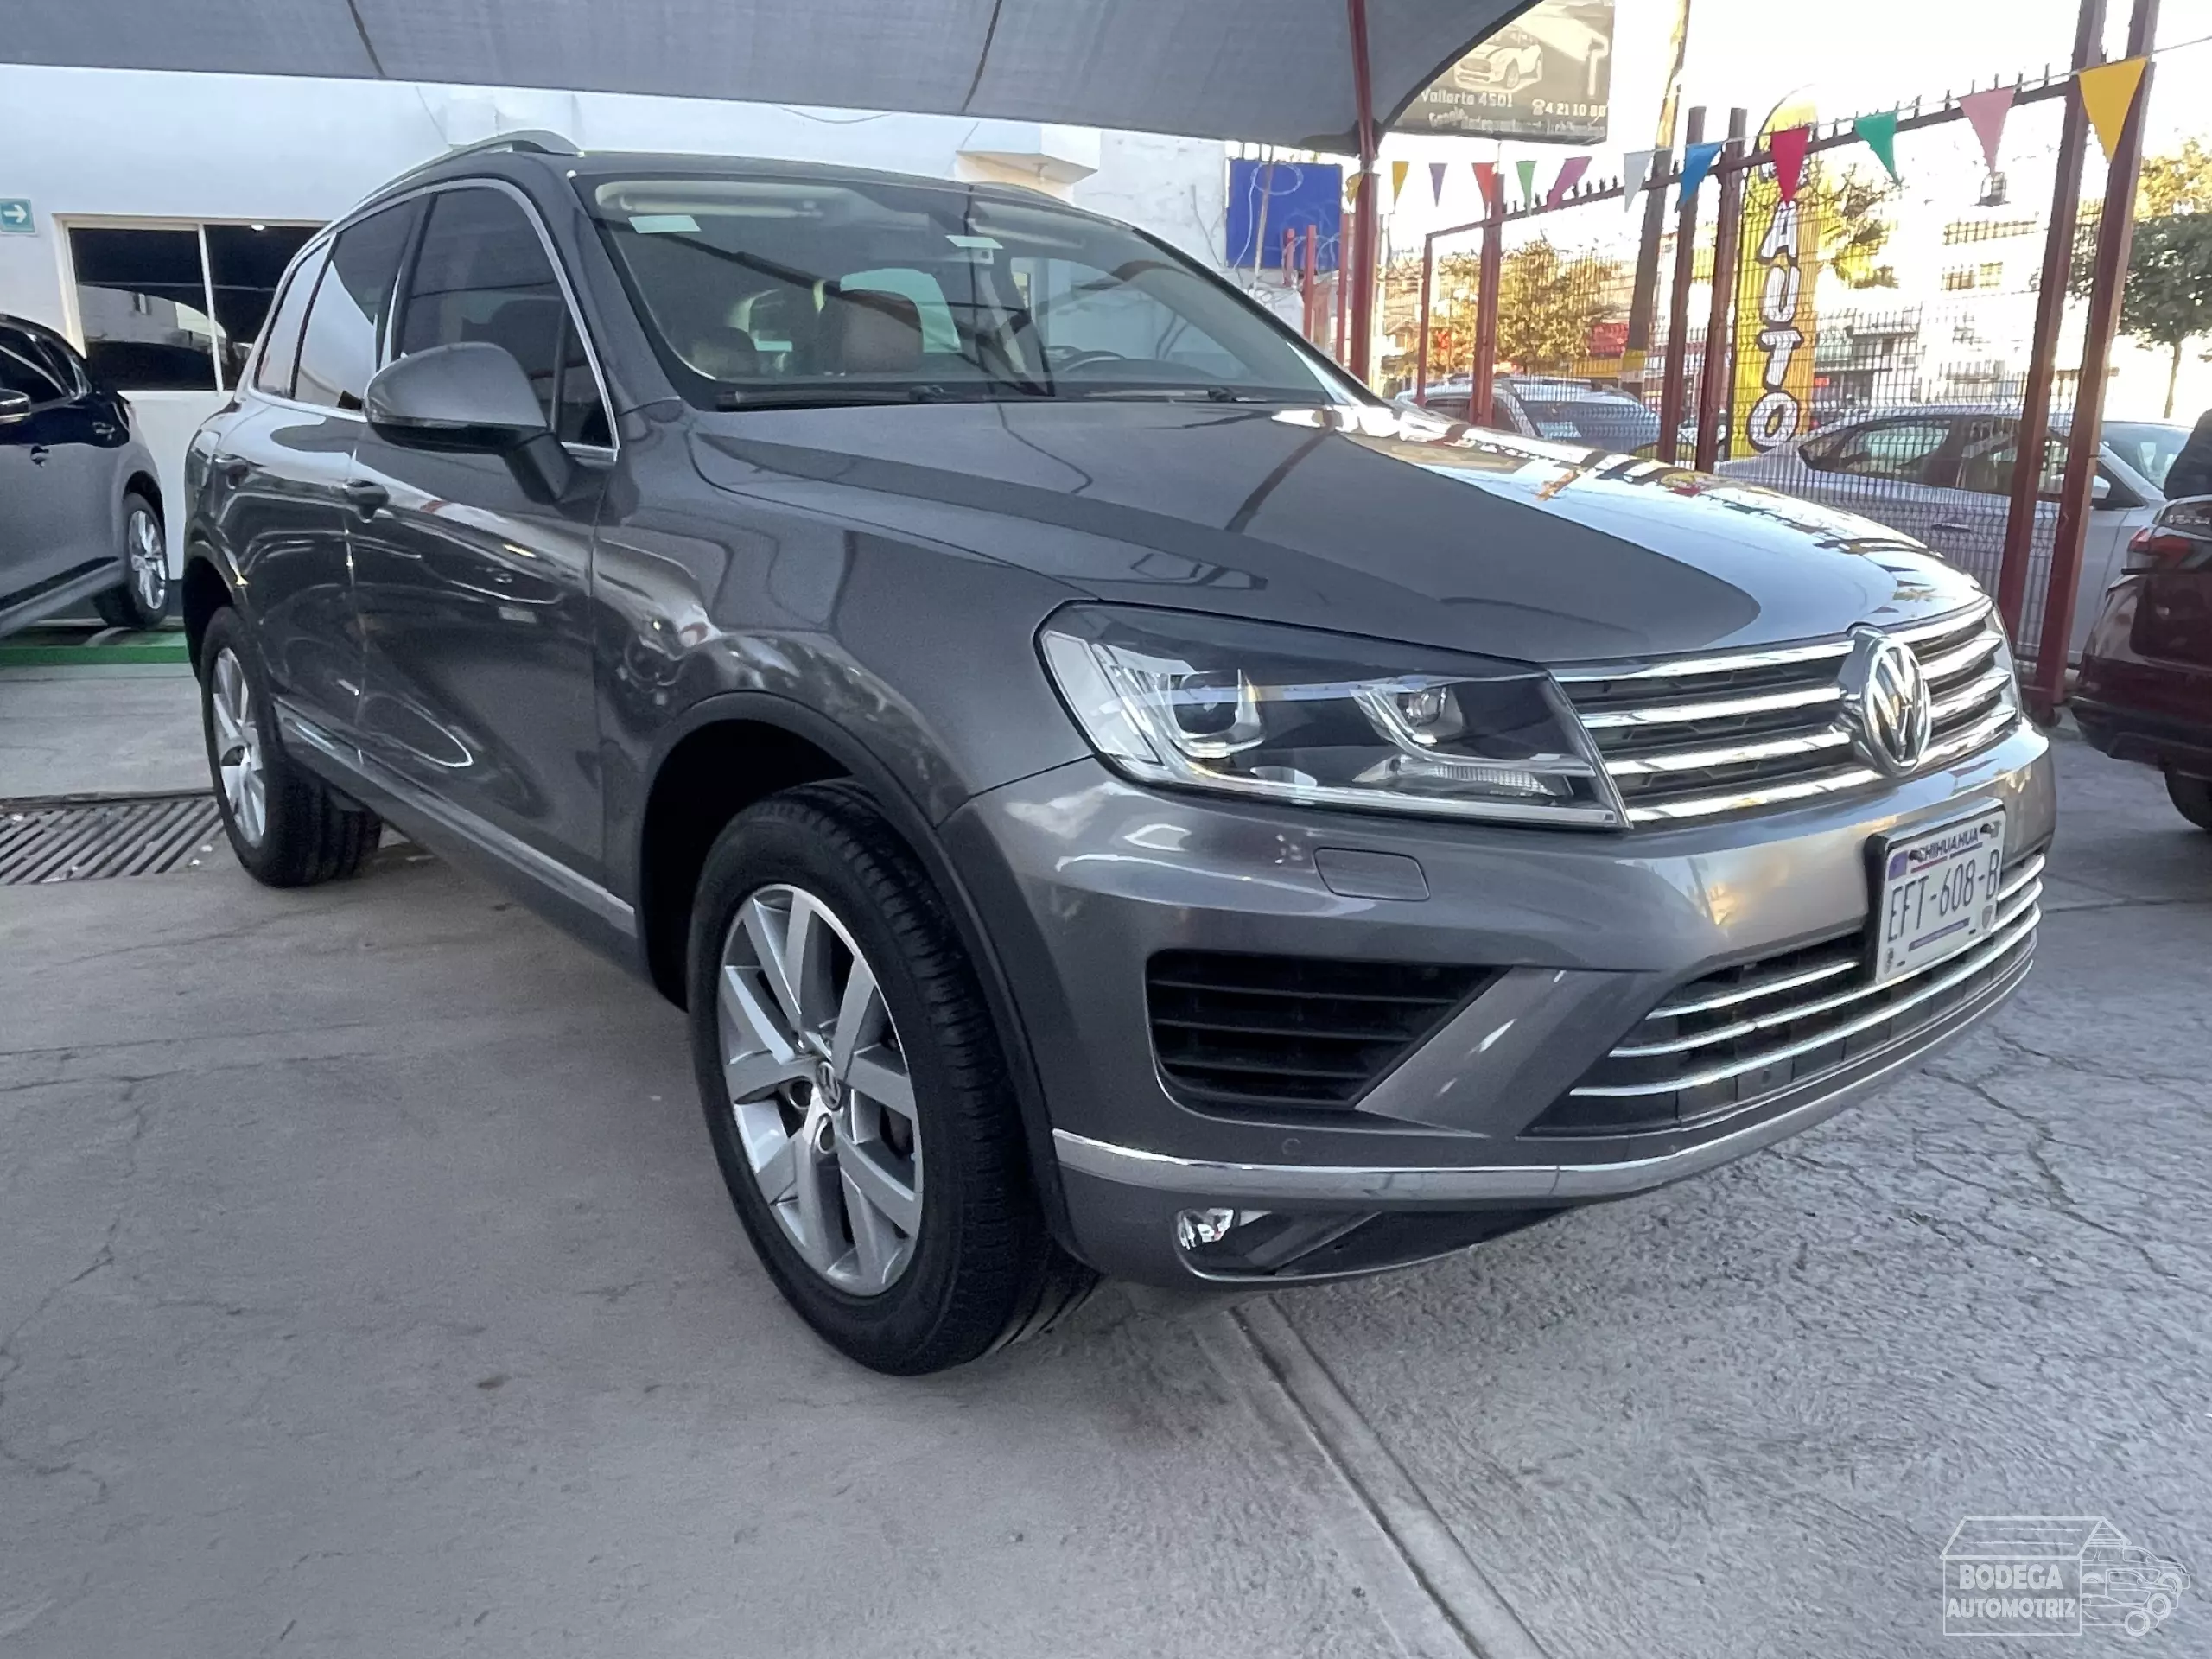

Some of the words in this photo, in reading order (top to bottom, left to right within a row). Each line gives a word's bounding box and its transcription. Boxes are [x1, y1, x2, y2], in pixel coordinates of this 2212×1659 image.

[1421, 88, 1474, 105] Vallarta
[1478, 91, 1513, 108] 4501
[1556, 102, 1569, 116] 21
[1573, 103, 1587, 117] 10
[1749, 200, 1802, 448] AUTO
[1888, 849, 1999, 943] EFT-608-B
